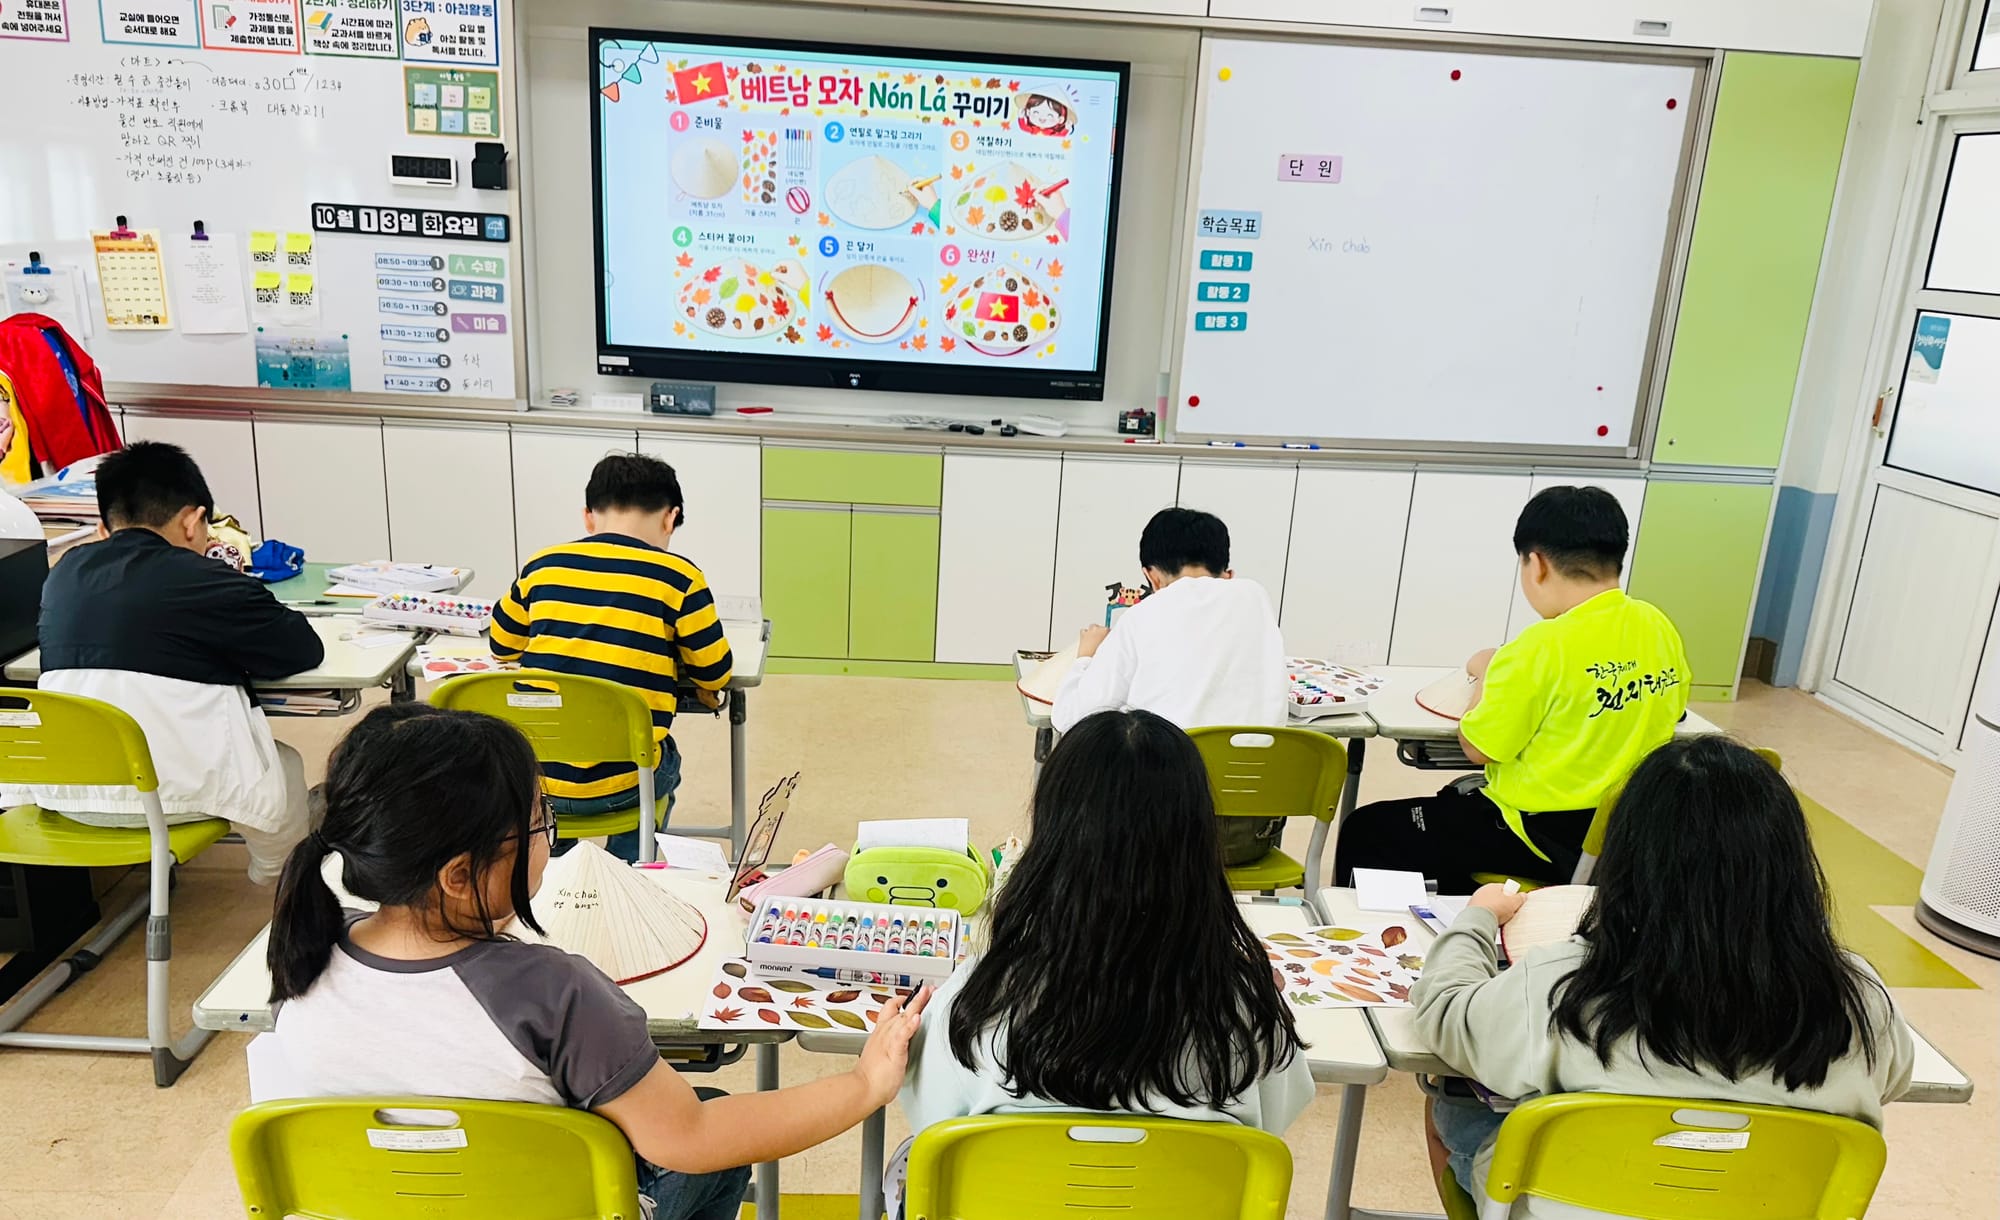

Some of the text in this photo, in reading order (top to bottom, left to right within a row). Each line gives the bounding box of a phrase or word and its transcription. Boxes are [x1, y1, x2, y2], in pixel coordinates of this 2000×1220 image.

[403, 0, 435, 13] 3단계
[445, 3, 493, 17] 아침활동
[119, 13, 180, 24] 교실에 들어오면
[341, 18, 394, 29] 시간표에 따라
[124, 25, 177, 36] 순서대로 해요
[331, 28, 392, 40] 교과서를 바르게
[459, 24, 486, 34] 요일 별
[313, 39, 330, 49] 책상
[332, 40, 349, 50] 속에
[440, 34, 456, 44] 아침
[741, 75, 1010, 119] 베트남 모자 Nón Lá 꾸미기
[694, 116, 723, 130] 준비물
[830, 125, 839, 139] 2
[849, 127, 872, 138] 연필로
[900, 131, 922, 141] 그리기
[158, 135, 176, 147] QR
[956, 132, 1012, 150] 3 색칠하기
[317, 206, 478, 236] 10월 13일 화요일
[1203, 216, 1256, 234] 학습목표
[677, 229, 754, 244] 4 스티커 붙이기
[825, 240, 834, 254] 5
[857, 241, 874, 252] 달기
[946, 248, 995, 264] 6 완성!
[471, 260, 498, 275] 수학
[434, 279, 442, 290] 2
[471, 285, 498, 300] 과학
[437, 303, 445, 315] 3
[439, 331, 447, 340] 4
[441, 357, 448, 367] 5
[440, 381, 447, 390] 6
[760, 963, 793, 972] monami
